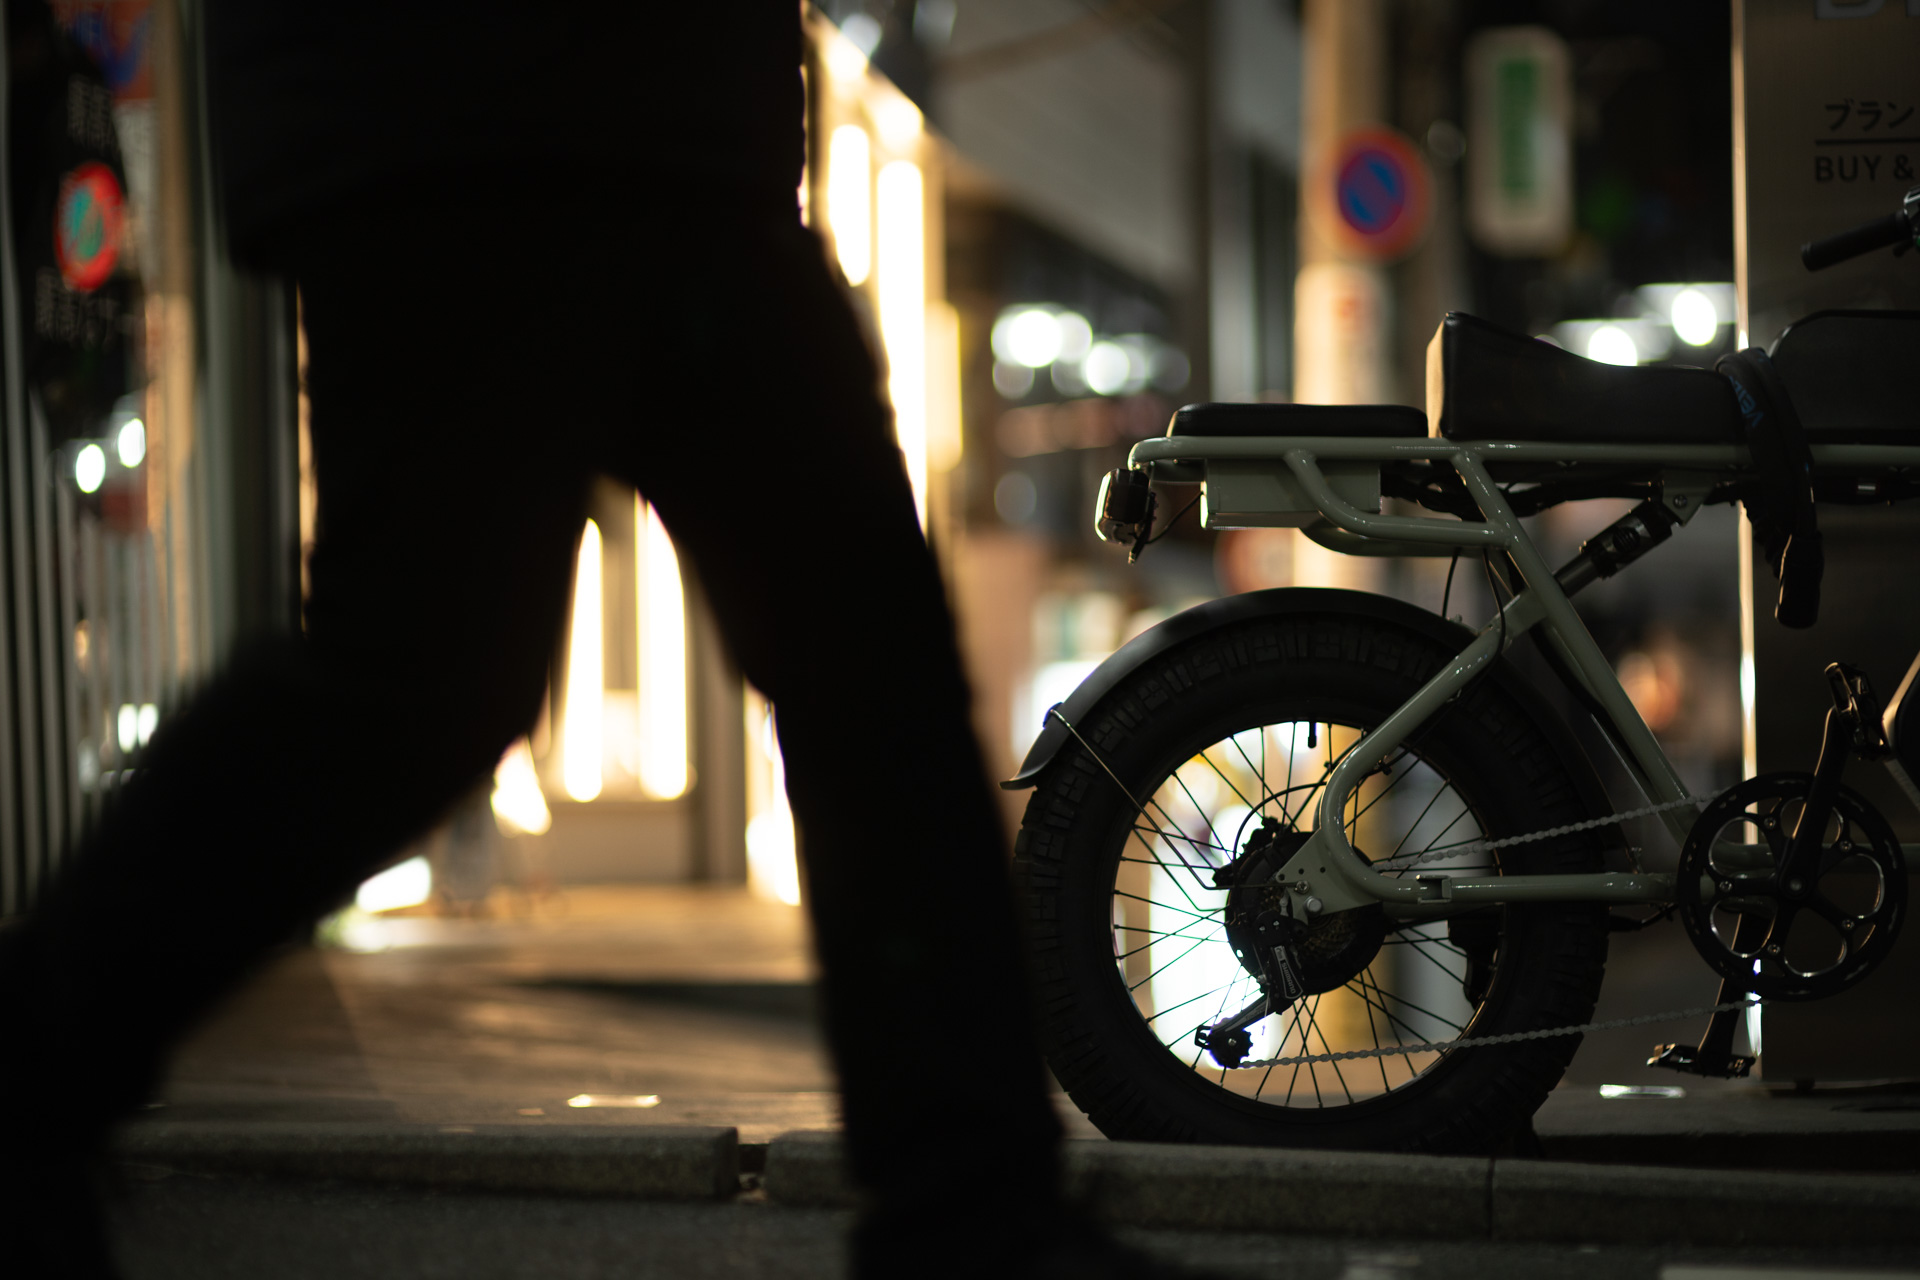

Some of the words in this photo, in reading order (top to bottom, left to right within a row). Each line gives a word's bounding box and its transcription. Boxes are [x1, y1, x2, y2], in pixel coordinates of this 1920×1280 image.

[1815, 155, 1881, 181] BUY
[1893, 154, 1915, 180] &
[1281, 962, 1296, 994] SHIMANO
